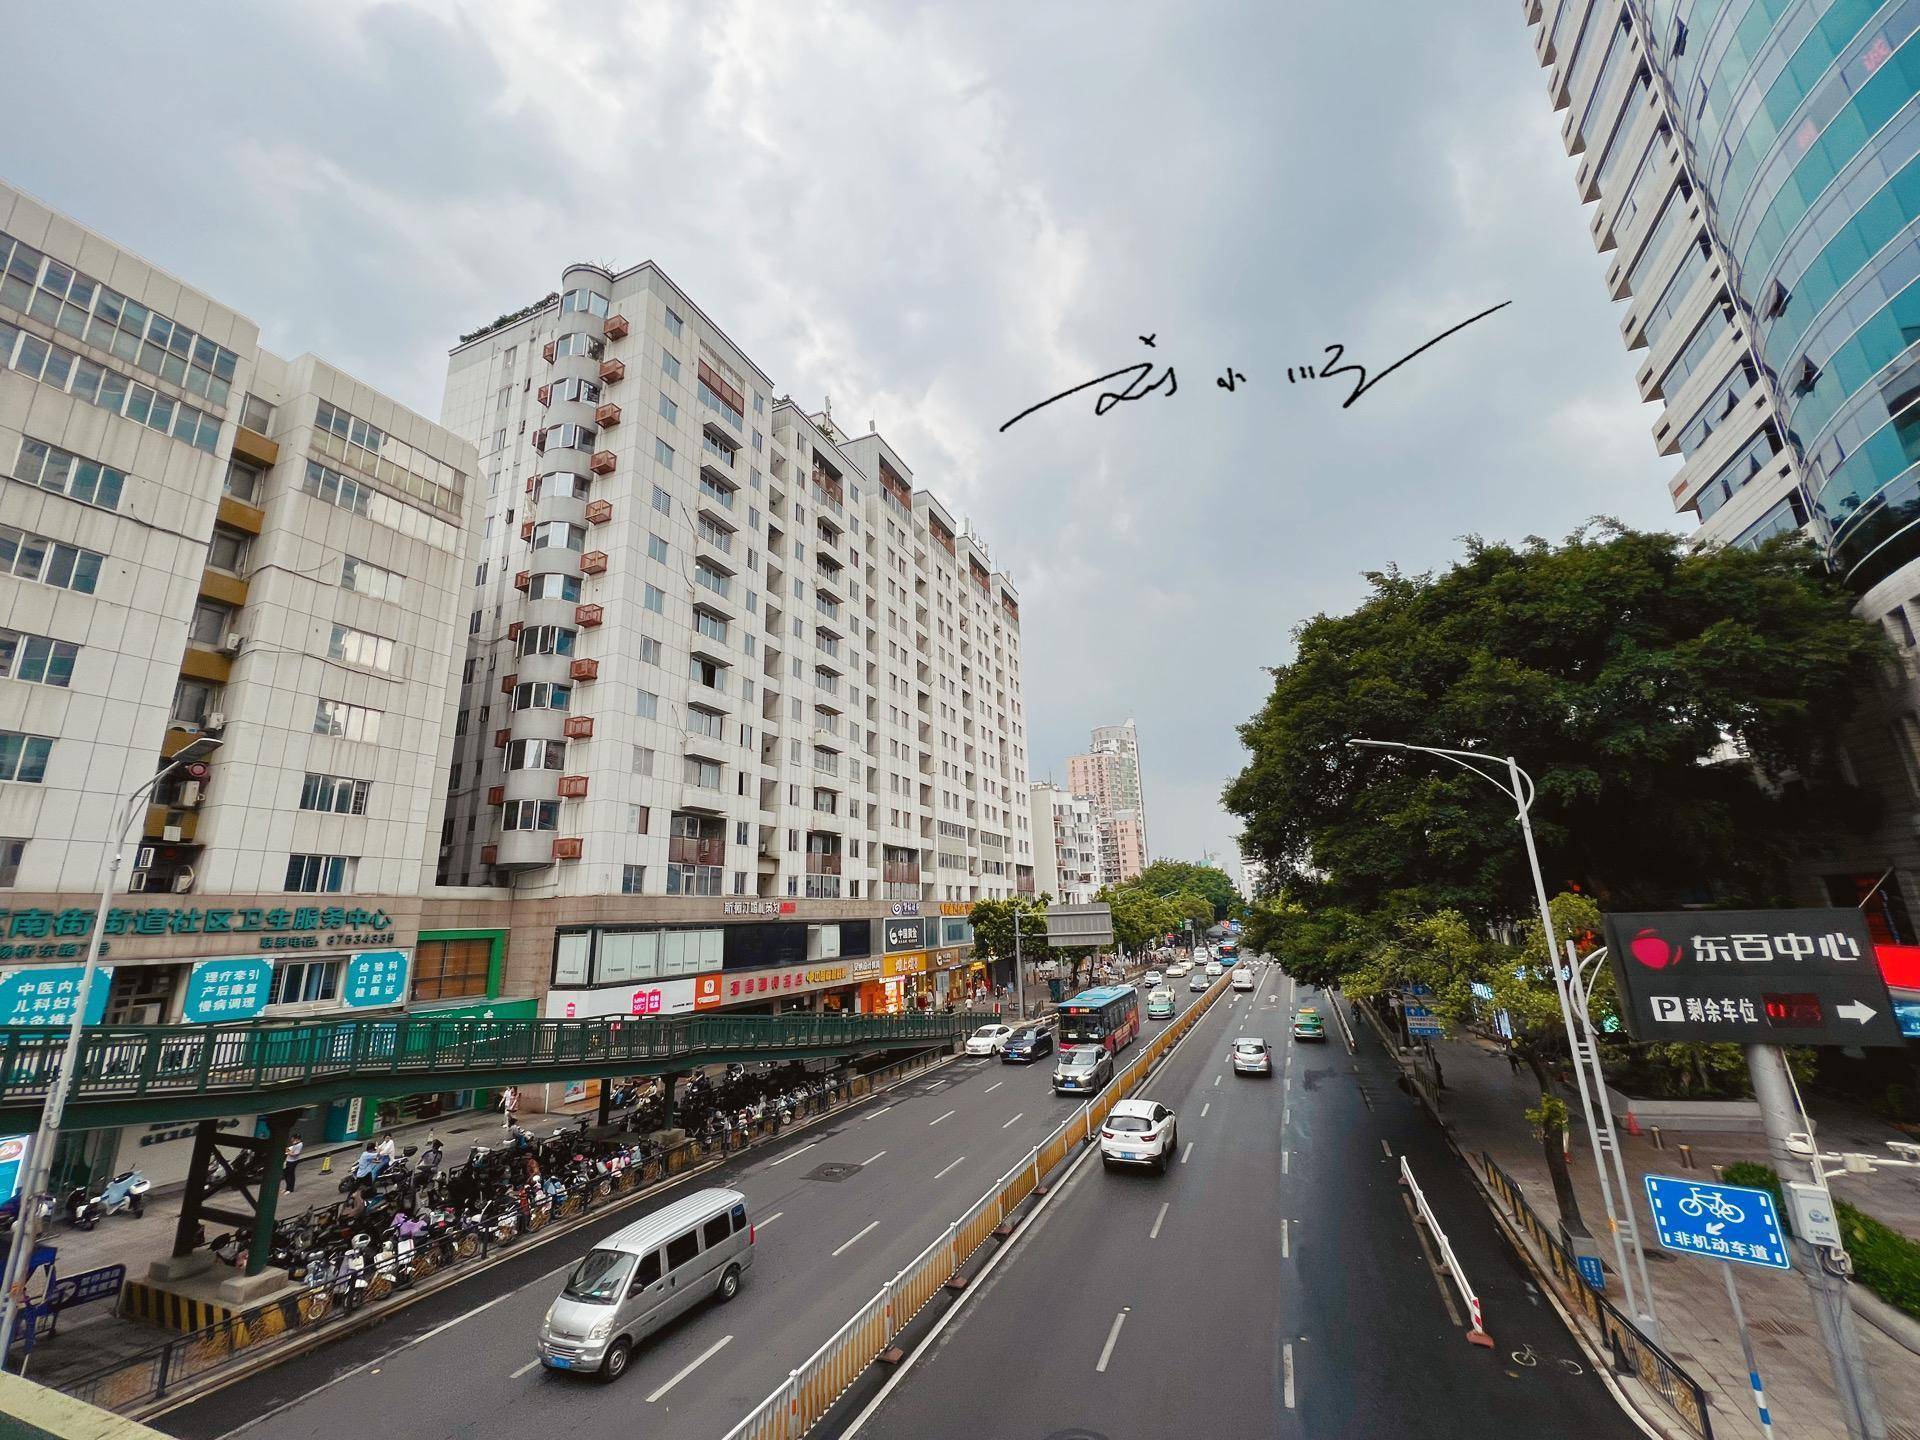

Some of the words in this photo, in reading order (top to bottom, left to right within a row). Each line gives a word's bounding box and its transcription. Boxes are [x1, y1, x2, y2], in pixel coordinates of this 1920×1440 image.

[0, 906, 392, 938] 南街街道社区卫生服务中心
[1691, 932, 1861, 962] 东百中心
[1686, 998, 1758, 1023] 剩余车位
[1674, 1231, 1770, 1261] 非机动车道
